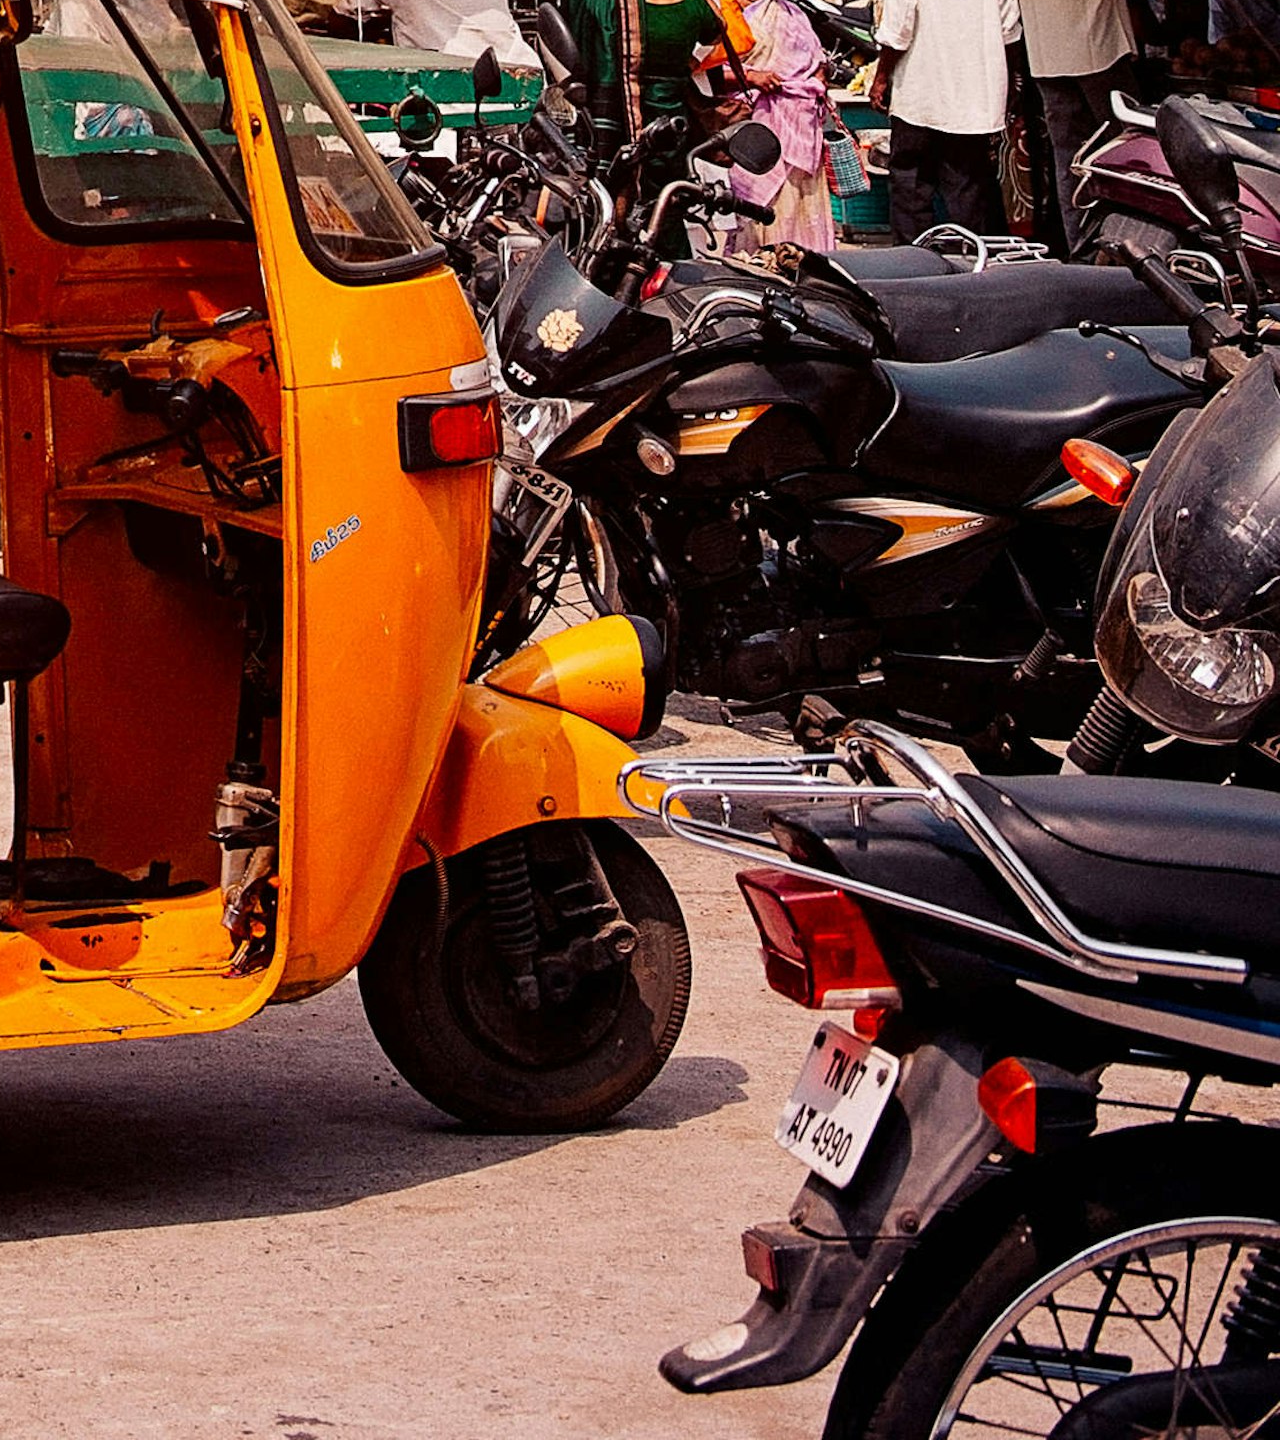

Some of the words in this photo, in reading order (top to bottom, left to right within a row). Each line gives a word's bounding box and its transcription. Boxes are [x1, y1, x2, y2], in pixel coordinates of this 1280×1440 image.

[506, 361, 537, 387] TVS
[823, 1047, 851, 1091] TN
[842, 1061, 868, 1100] 07
[787, 1104, 817, 1144] AT
[812, 1116, 853, 1169] 4990
